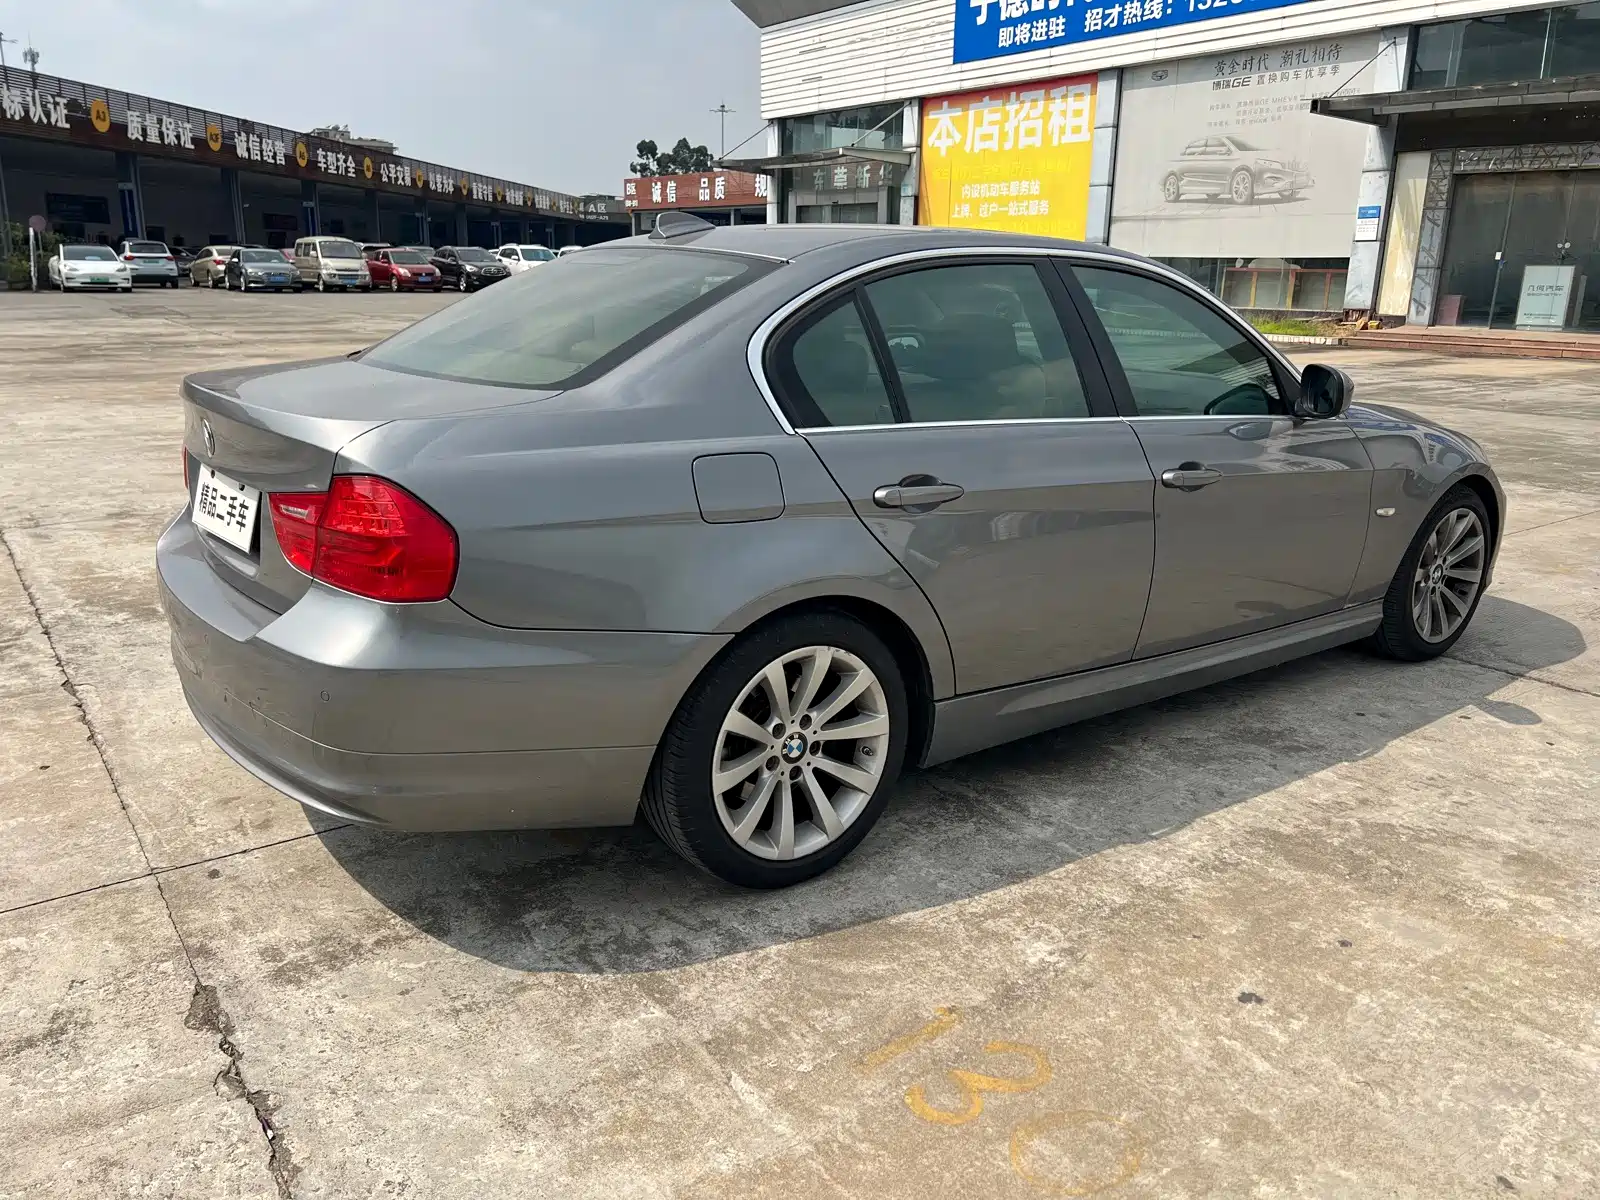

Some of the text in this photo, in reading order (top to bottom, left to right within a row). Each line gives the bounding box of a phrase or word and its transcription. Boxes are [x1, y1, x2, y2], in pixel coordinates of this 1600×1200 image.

[998, 15, 1066, 48] 即将进驻
[1214, 43, 1343, 77] 黄金时代 潮礼相待
[1213, 65, 1340, 91] 博瑞GE 置换购车优享季
[1, 83, 70, 128] 标认证
[927, 83, 1093, 157] 本店招租
[127, 110, 195, 149] 质量保证
[234, 131, 286, 166] 诚信经营
[317, 147, 356, 178] 车型齐全
[380, 162, 412, 187] 公平交易
[652, 181, 677, 203] 诚信
[699, 176, 725, 201] 品质
[961, 180, 1040, 199] 内设机动车服务站
[589, 203, 607, 213] A区
[199, 481, 249, 532] 精品二手车
